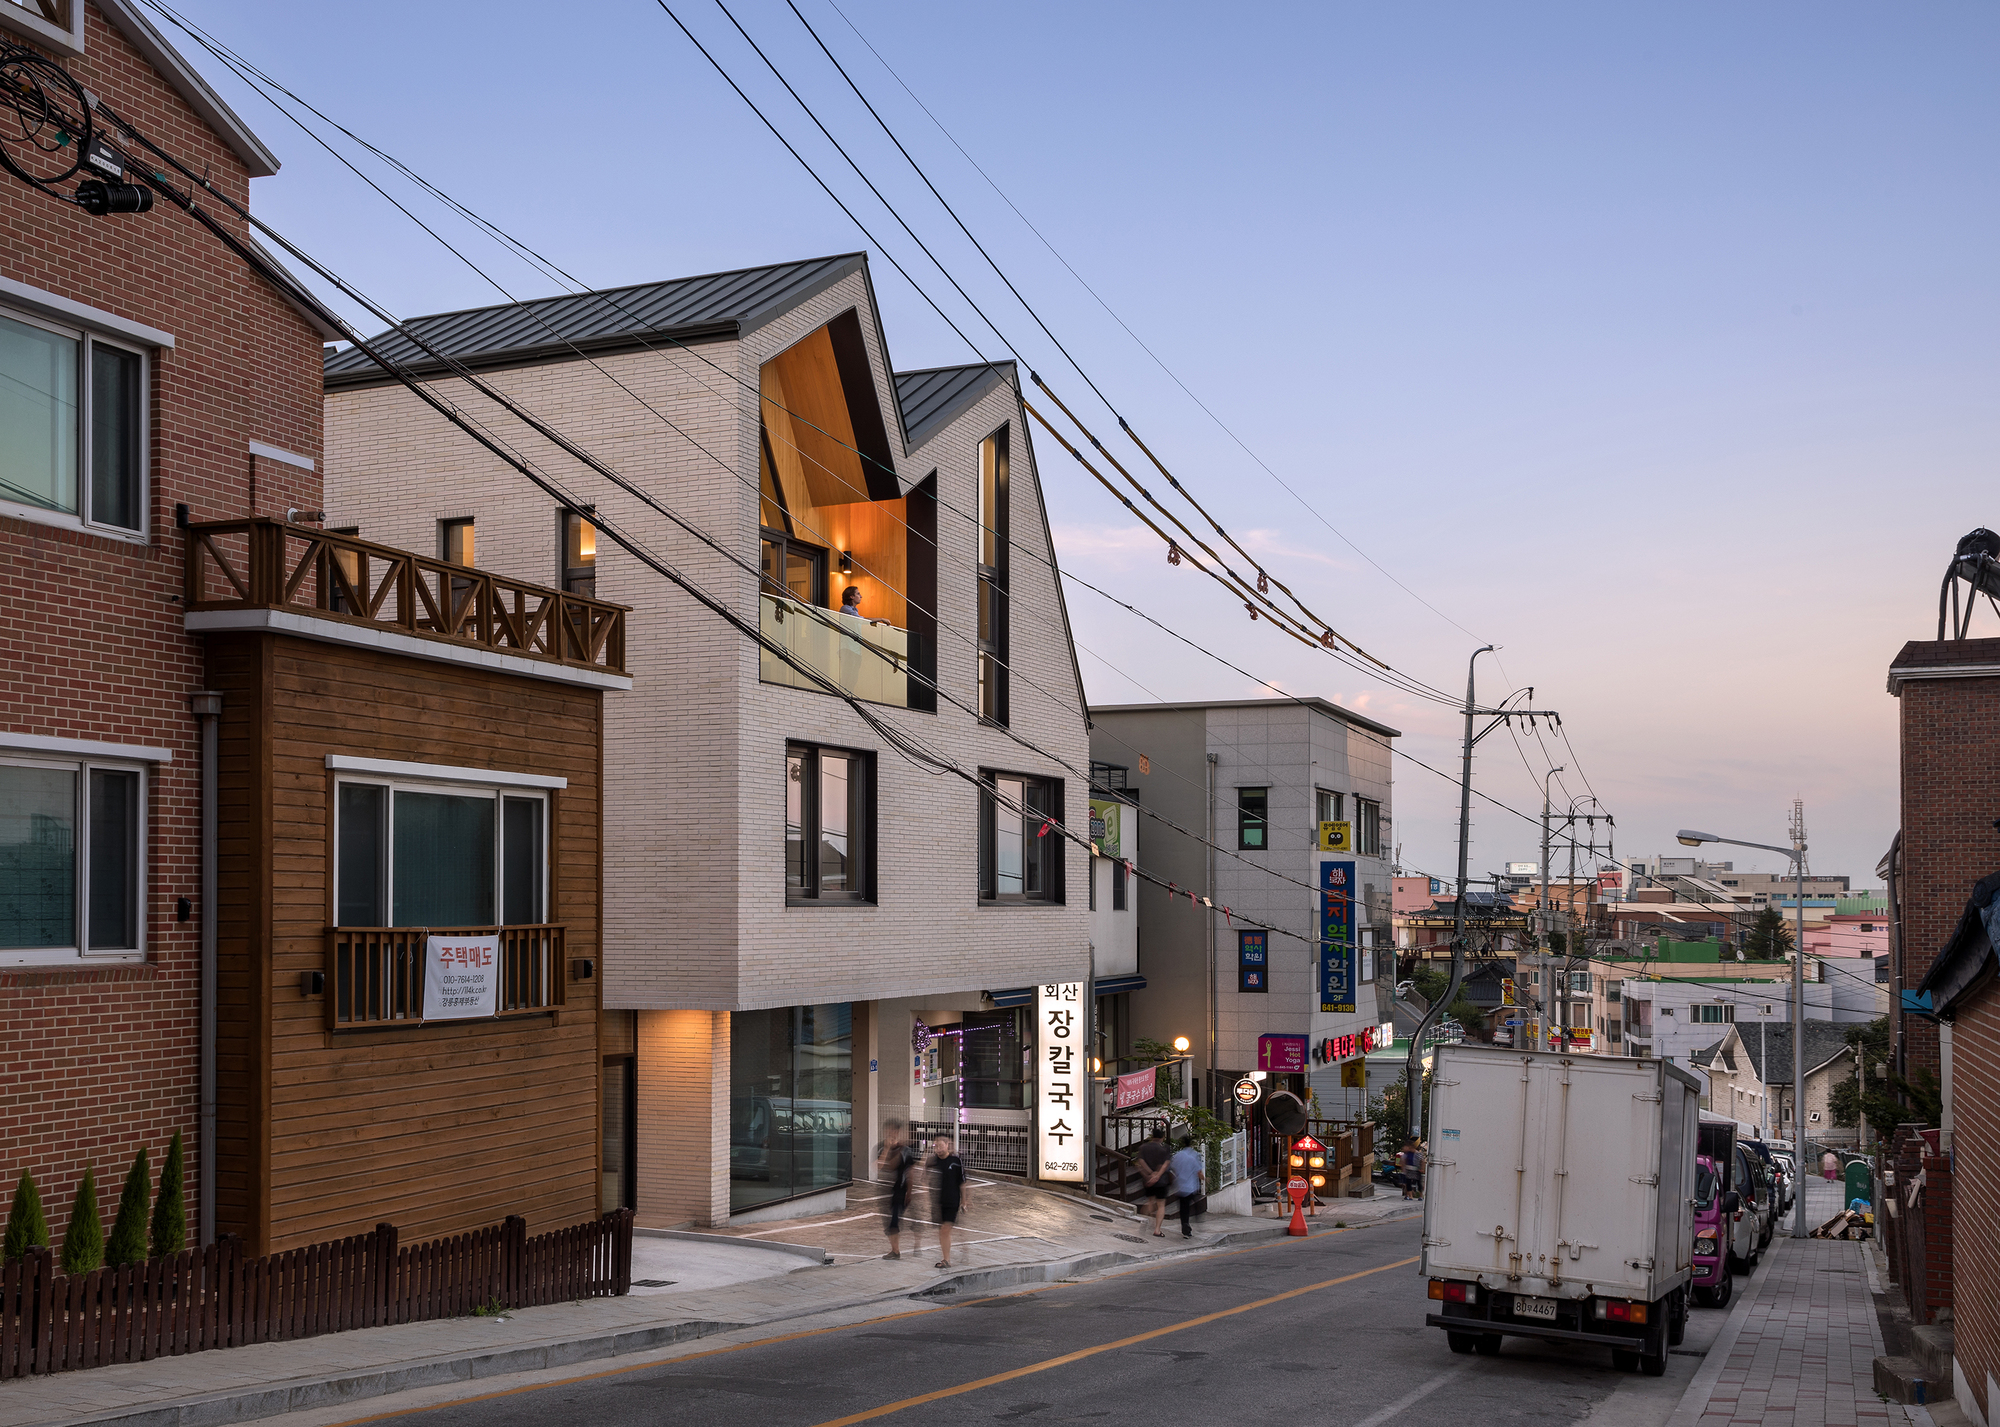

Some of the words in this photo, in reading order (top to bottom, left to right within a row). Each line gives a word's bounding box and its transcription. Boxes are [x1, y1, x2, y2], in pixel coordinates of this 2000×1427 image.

[1244, 945, 1263, 953] 역사
[440, 946, 492, 969] 주택매도
[1245, 952, 1263, 962] 학원
[1045, 984, 1078, 1001] 회산
[1322, 1003, 1355, 1013] 641-9130
[1333, 1033, 1356, 1062] 투다리
[1048, 1009, 1075, 1146] 장칼국수
[1236, 1087, 1256, 1096] 투다리
[1045, 1162, 1078, 1171] 642-2756
